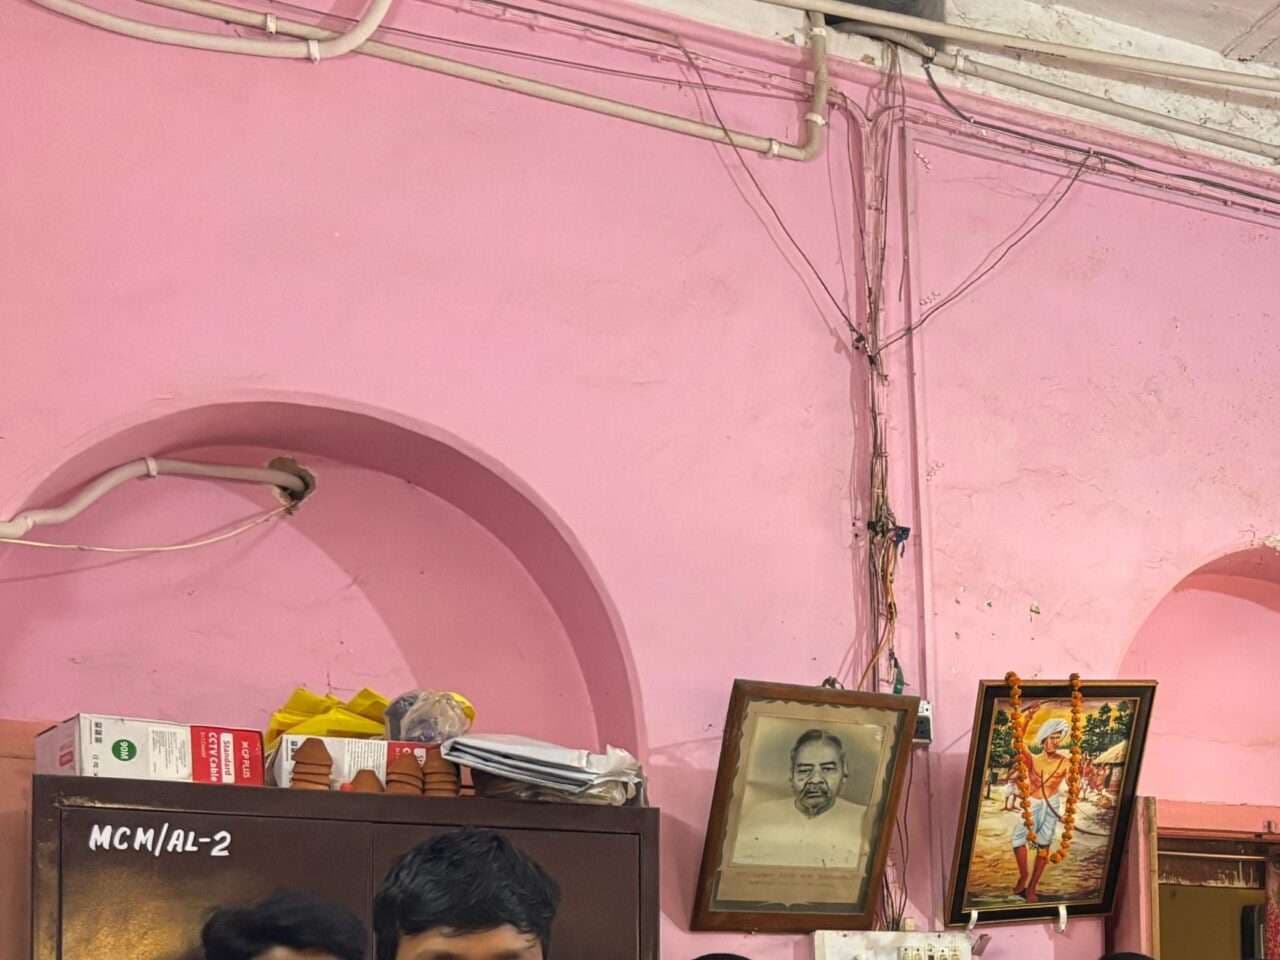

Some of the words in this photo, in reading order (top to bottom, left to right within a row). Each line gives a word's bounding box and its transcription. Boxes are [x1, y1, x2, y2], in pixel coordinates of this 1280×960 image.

[120, 741, 129, 760] 90M
[207, 731, 218, 757] CCTV
[210, 757, 220, 782] Cable
[222, 739, 232, 776] Standard
[88, 822, 232, 857] MCM/AL-2
